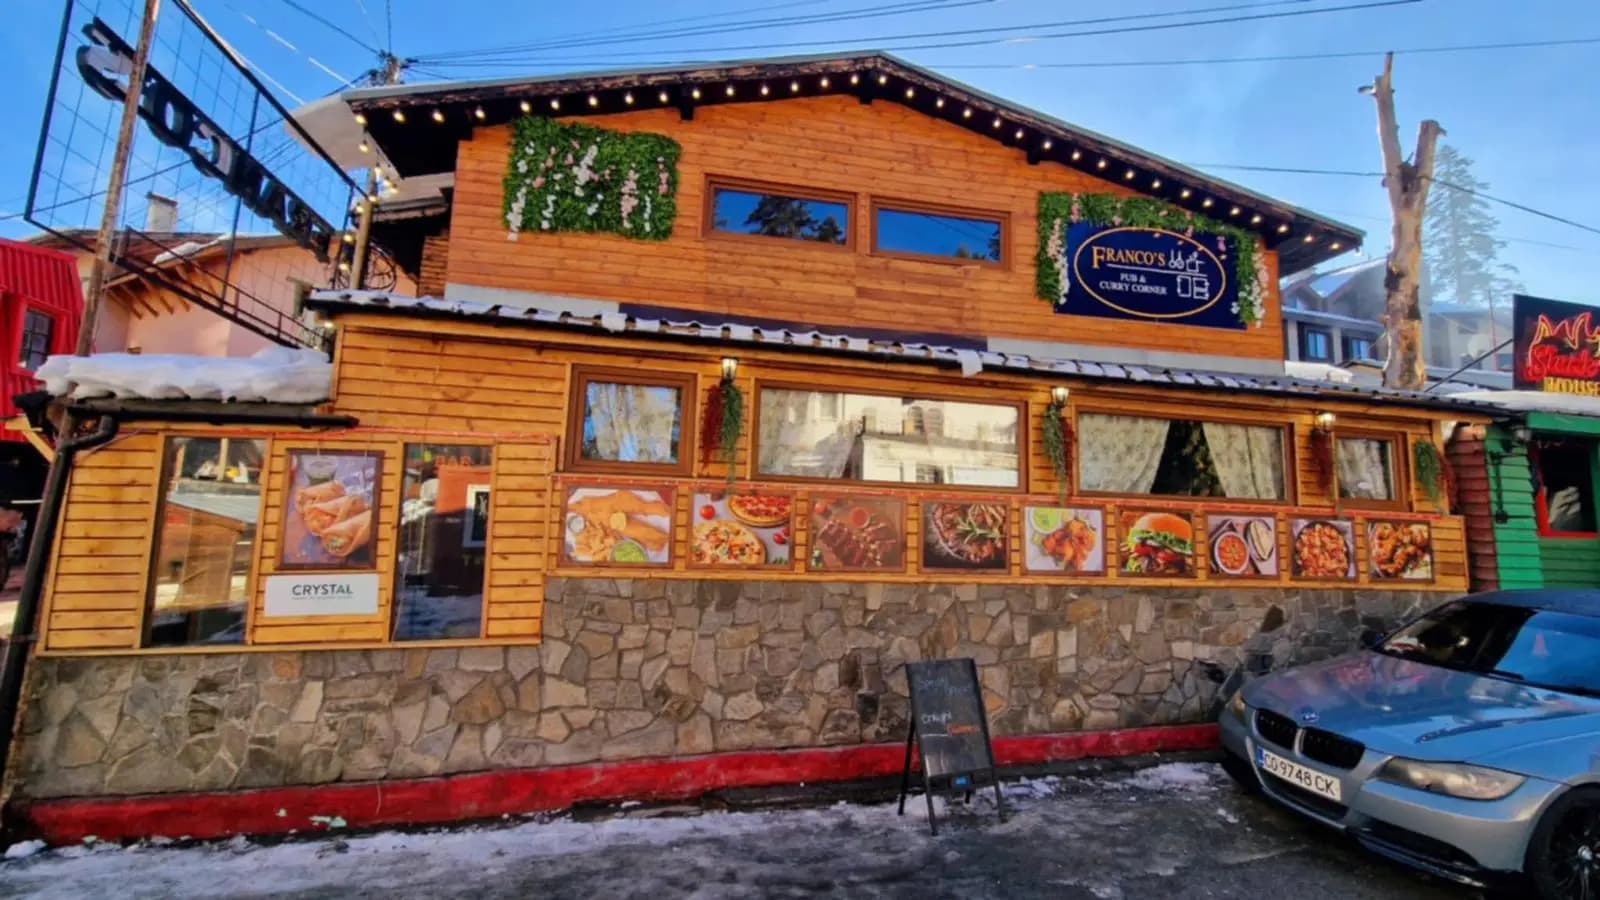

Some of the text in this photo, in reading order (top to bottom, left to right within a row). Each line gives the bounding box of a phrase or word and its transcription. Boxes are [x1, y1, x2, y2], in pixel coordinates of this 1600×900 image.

[1092, 246, 1166, 269] FRANCO'S
[1120, 272, 1146, 283] PUB &
[1099, 280, 1167, 295] CURRY CORNER
[292, 584, 353, 596] CRYSTAL
